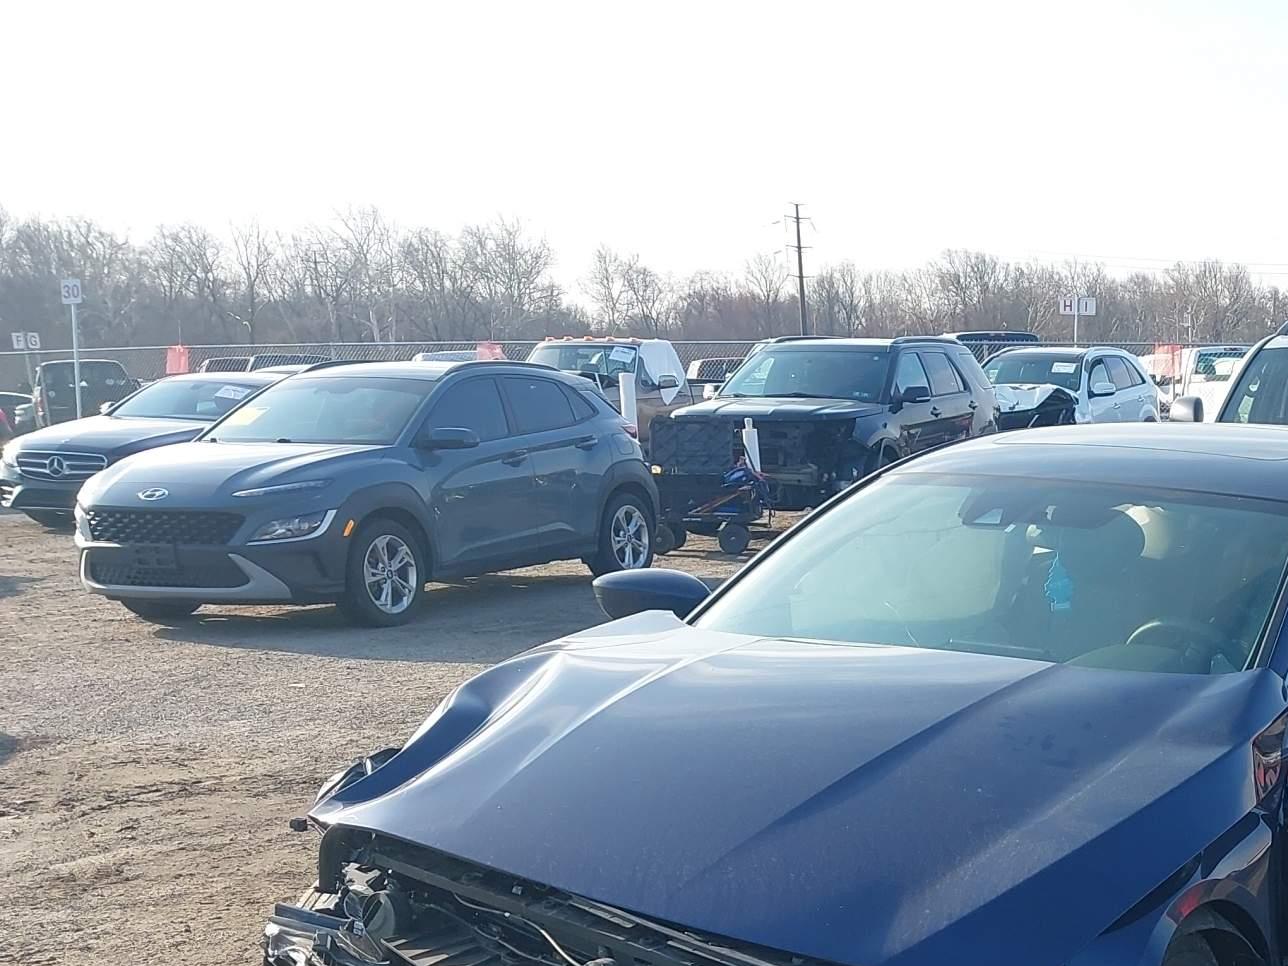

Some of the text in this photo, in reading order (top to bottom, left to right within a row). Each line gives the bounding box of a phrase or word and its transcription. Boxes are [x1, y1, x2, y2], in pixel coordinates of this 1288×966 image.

[63, 284, 80, 299] 30
[1063, 300, 1073, 312] H
[16, 336, 23, 345] F
[30, 335, 38, 346] G
